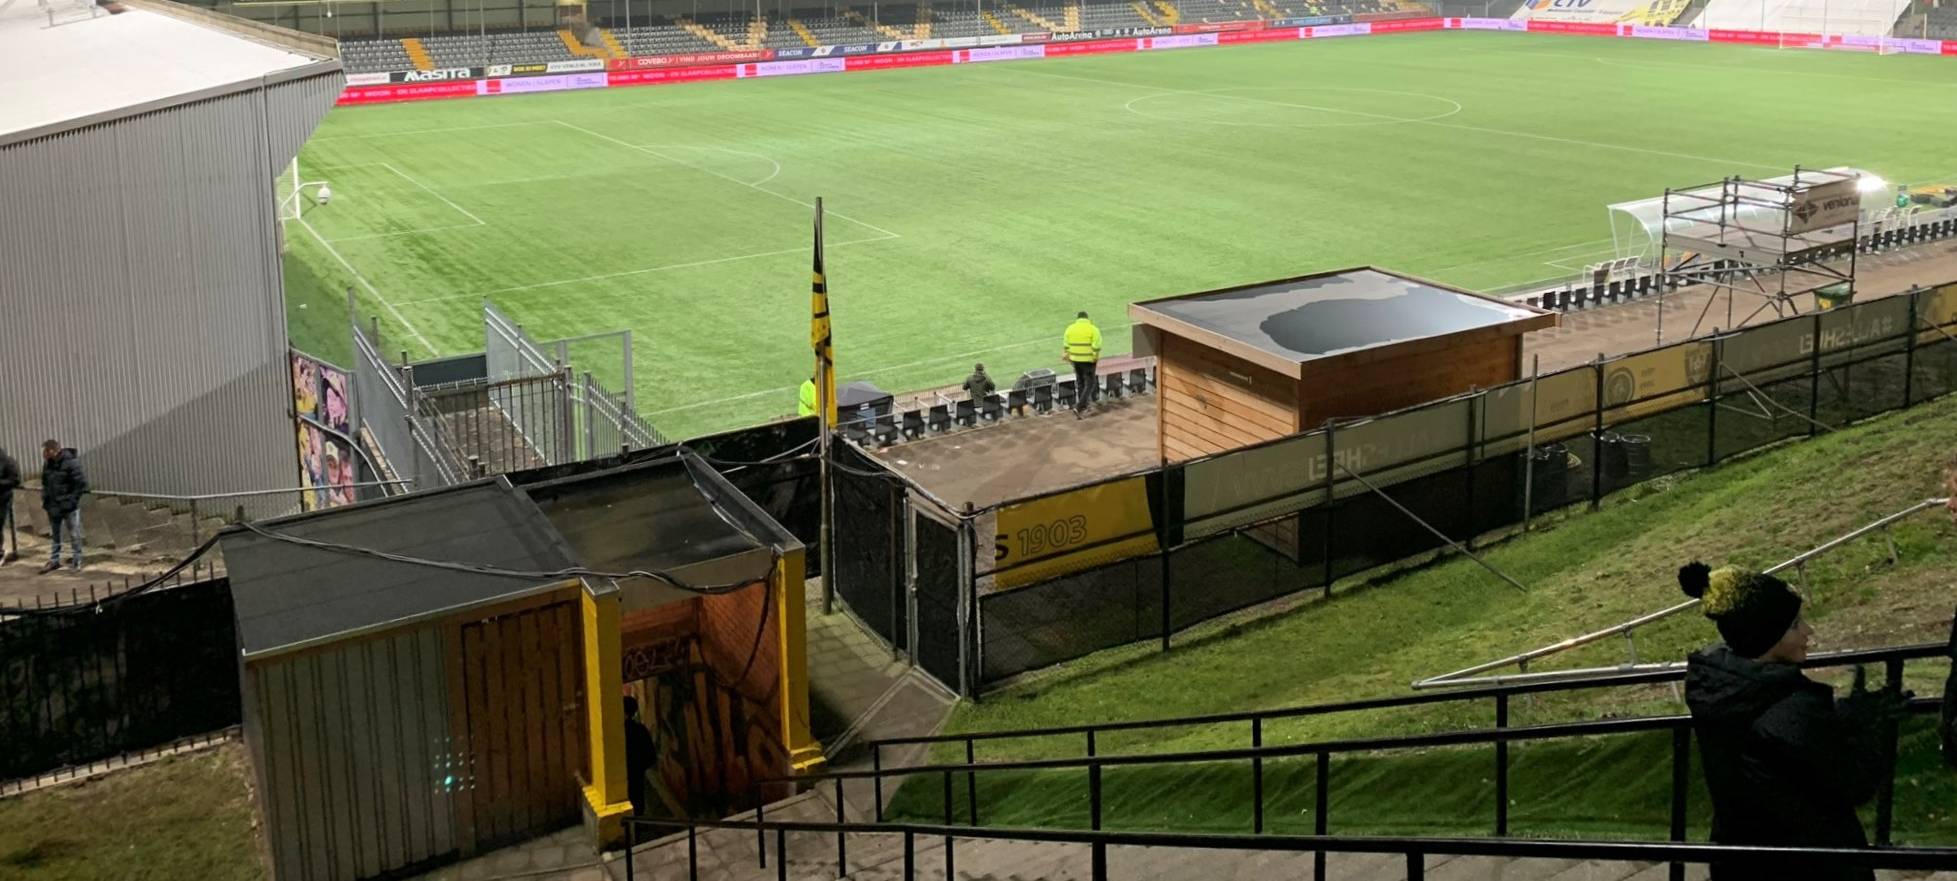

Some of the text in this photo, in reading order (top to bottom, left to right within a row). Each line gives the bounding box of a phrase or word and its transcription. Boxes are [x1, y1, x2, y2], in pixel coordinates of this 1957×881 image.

[1051, 30, 1093, 42] AutoArena
[1132, 27, 1172, 36] AutoArena
[1017, 514, 1087, 557] 1903
